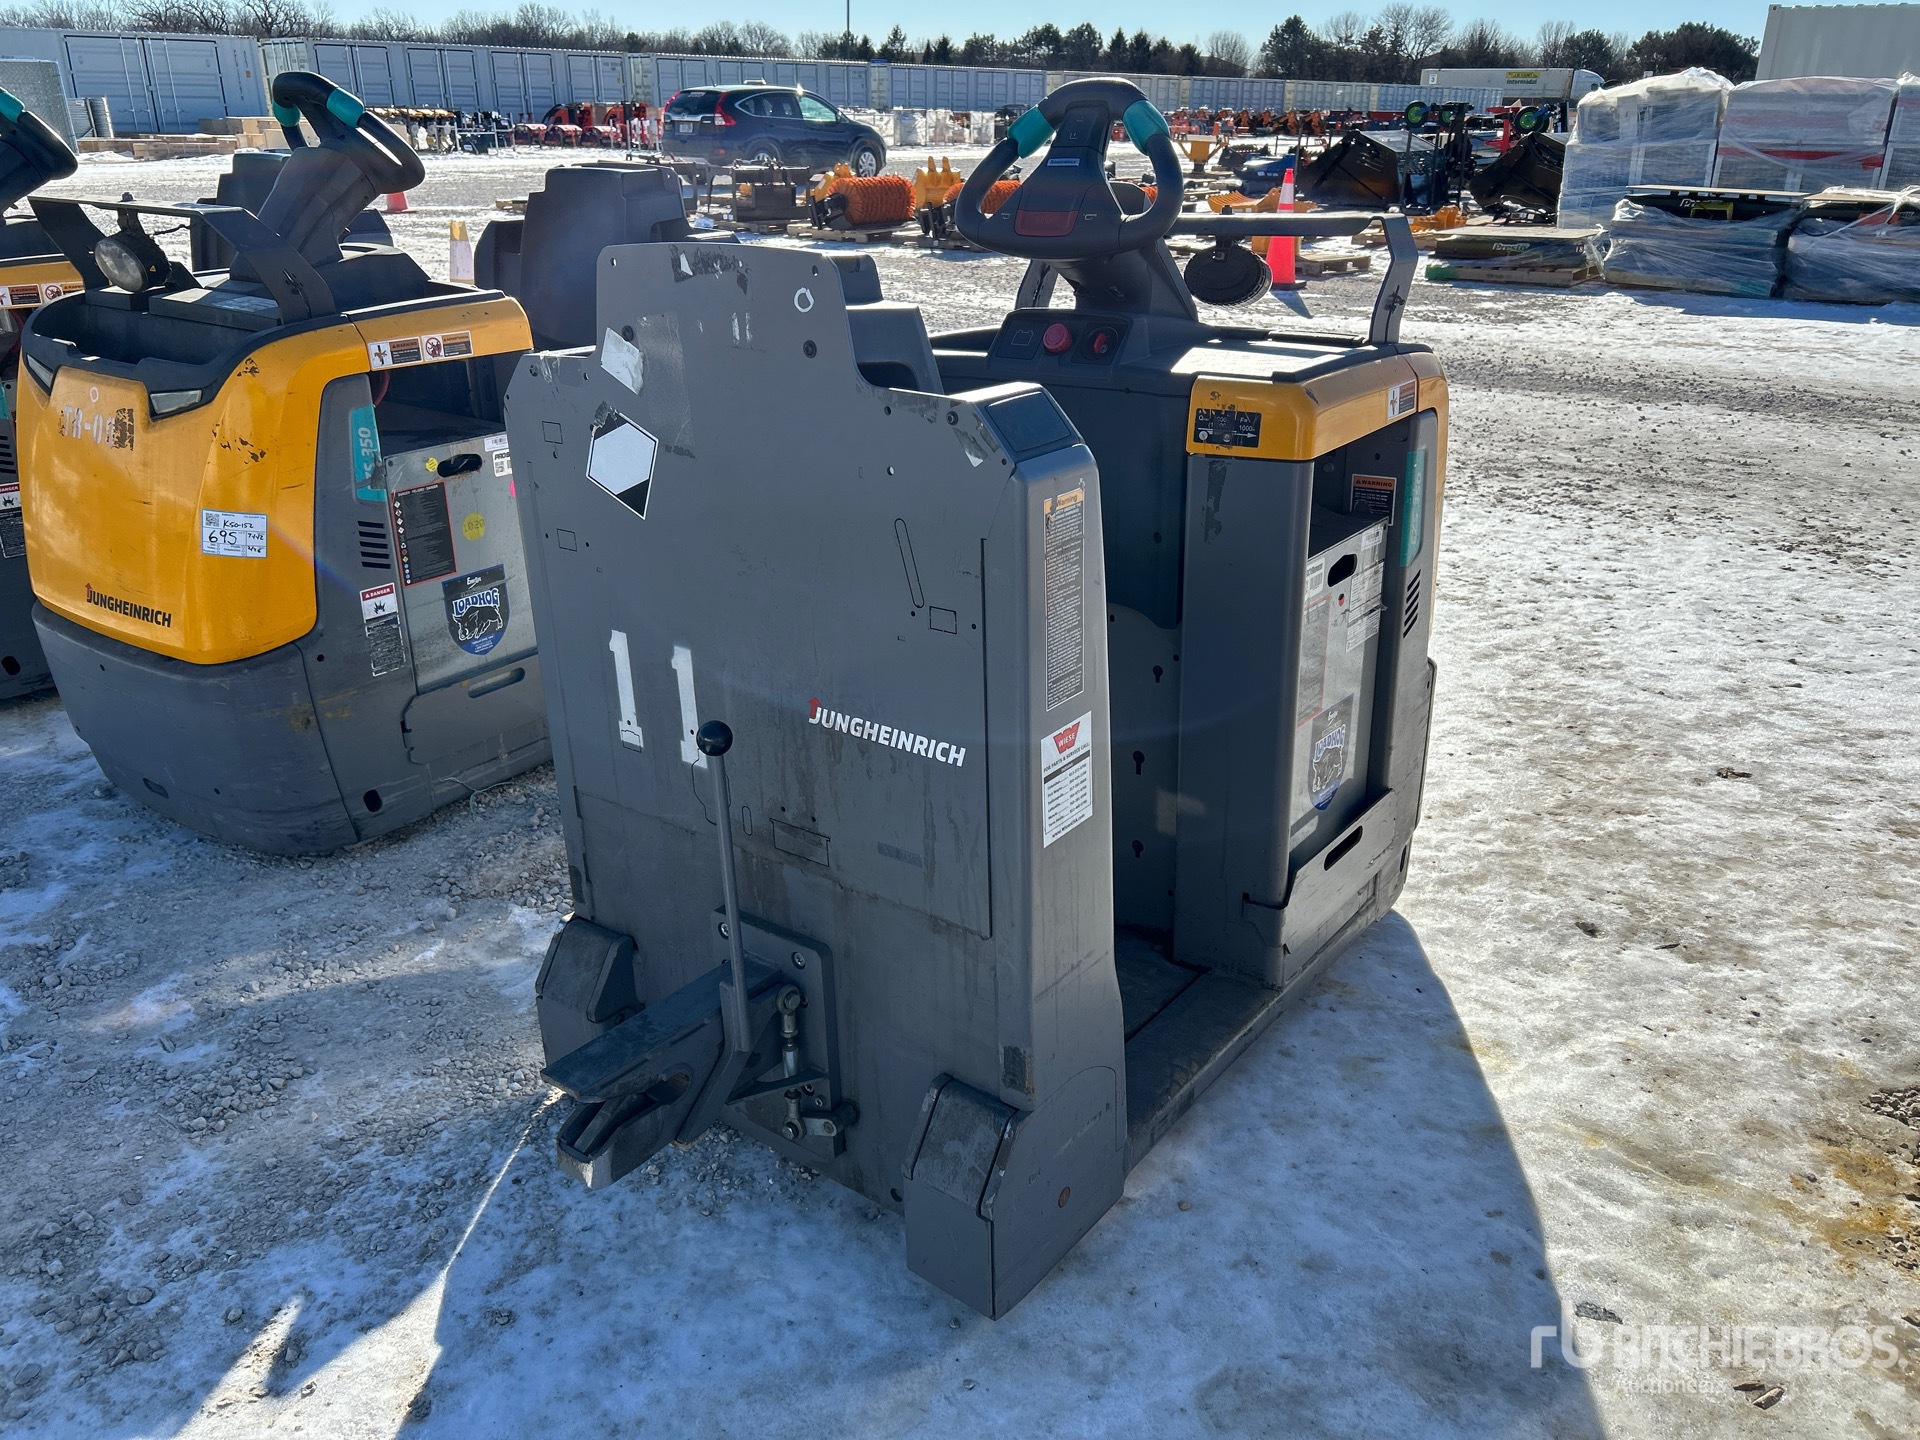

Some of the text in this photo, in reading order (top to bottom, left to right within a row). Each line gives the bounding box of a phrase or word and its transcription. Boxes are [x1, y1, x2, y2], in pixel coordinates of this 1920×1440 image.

[1361, 479, 1393, 488] WARNING
[208, 529, 238, 546] 695
[370, 587, 391, 598] DANGER
[85, 583, 172, 628] JUNGHEINRICH
[452, 587, 501, 617] LOADHOG
[808, 697, 967, 767] JUNGHEINRICH
[1057, 732, 1077, 748] WIESE
